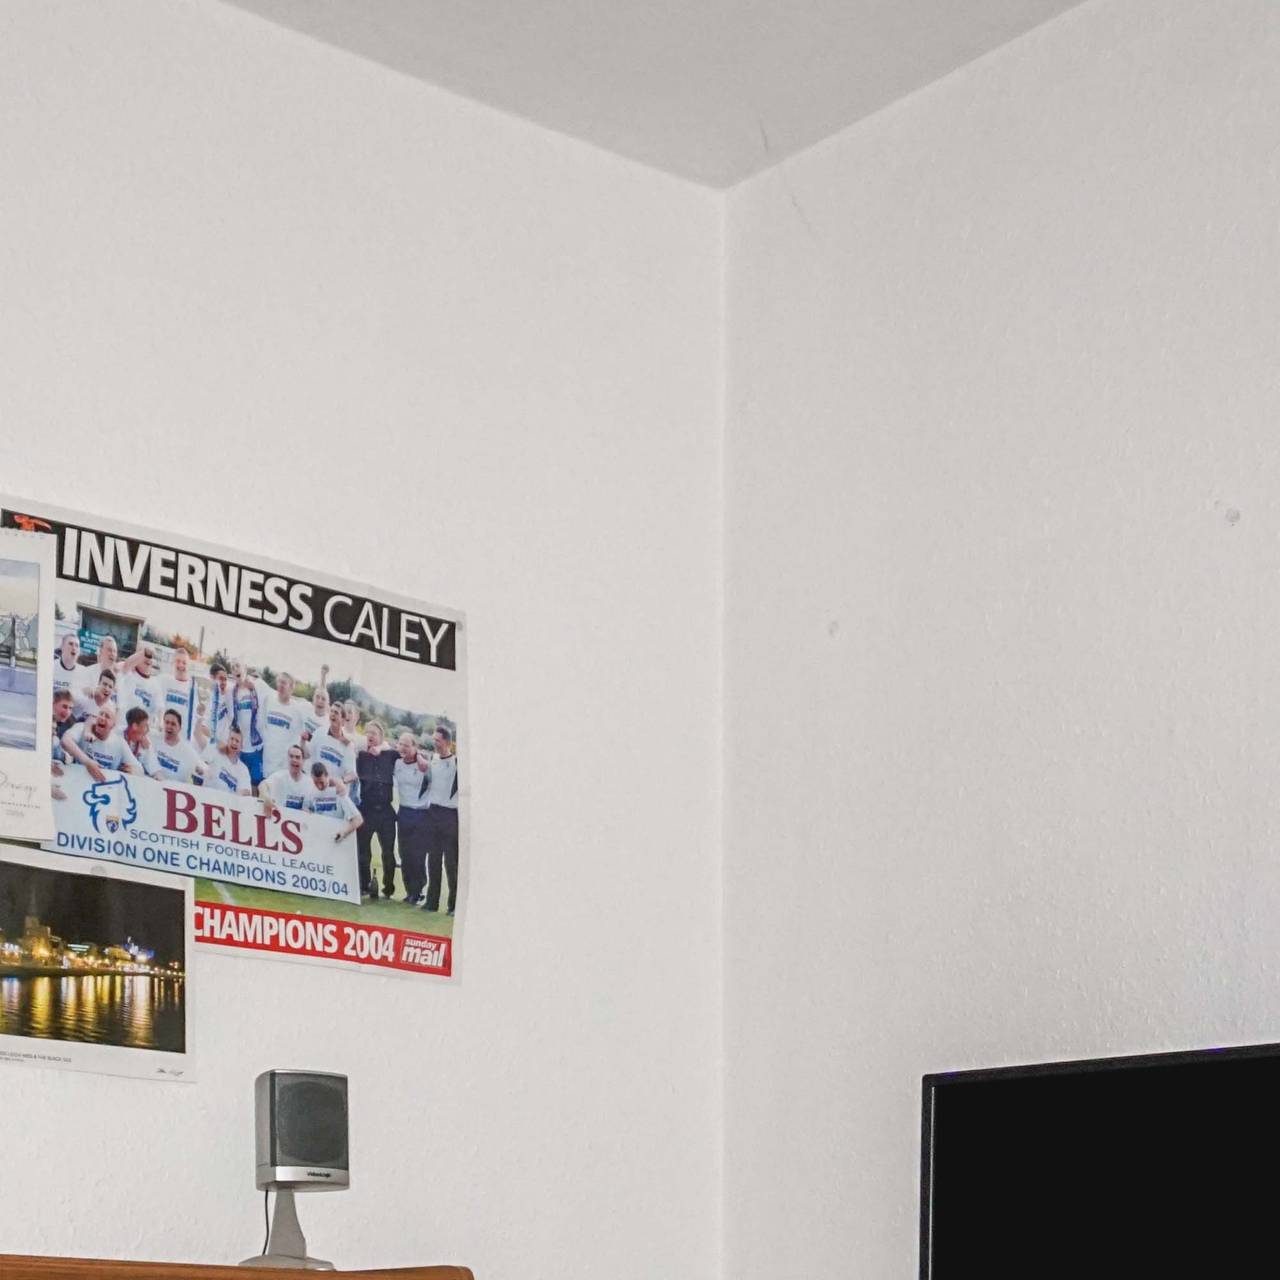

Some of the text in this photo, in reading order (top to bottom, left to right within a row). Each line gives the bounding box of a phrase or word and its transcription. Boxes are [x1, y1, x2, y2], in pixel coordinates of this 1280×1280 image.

[62, 527, 449, 663] INVERNESS CALEY
[161, 787, 304, 855] BELL'S
[56, 831, 349, 896] DIVISION ONE CHAMPIONS 2003/04
[129, 828, 334, 876] SCOTTISH FOOTBALL LEAGUE
[192, 905, 395, 962] CHAMPIONS 2004
[400, 942, 446, 968] mail
[404, 936, 437, 951] sunday
